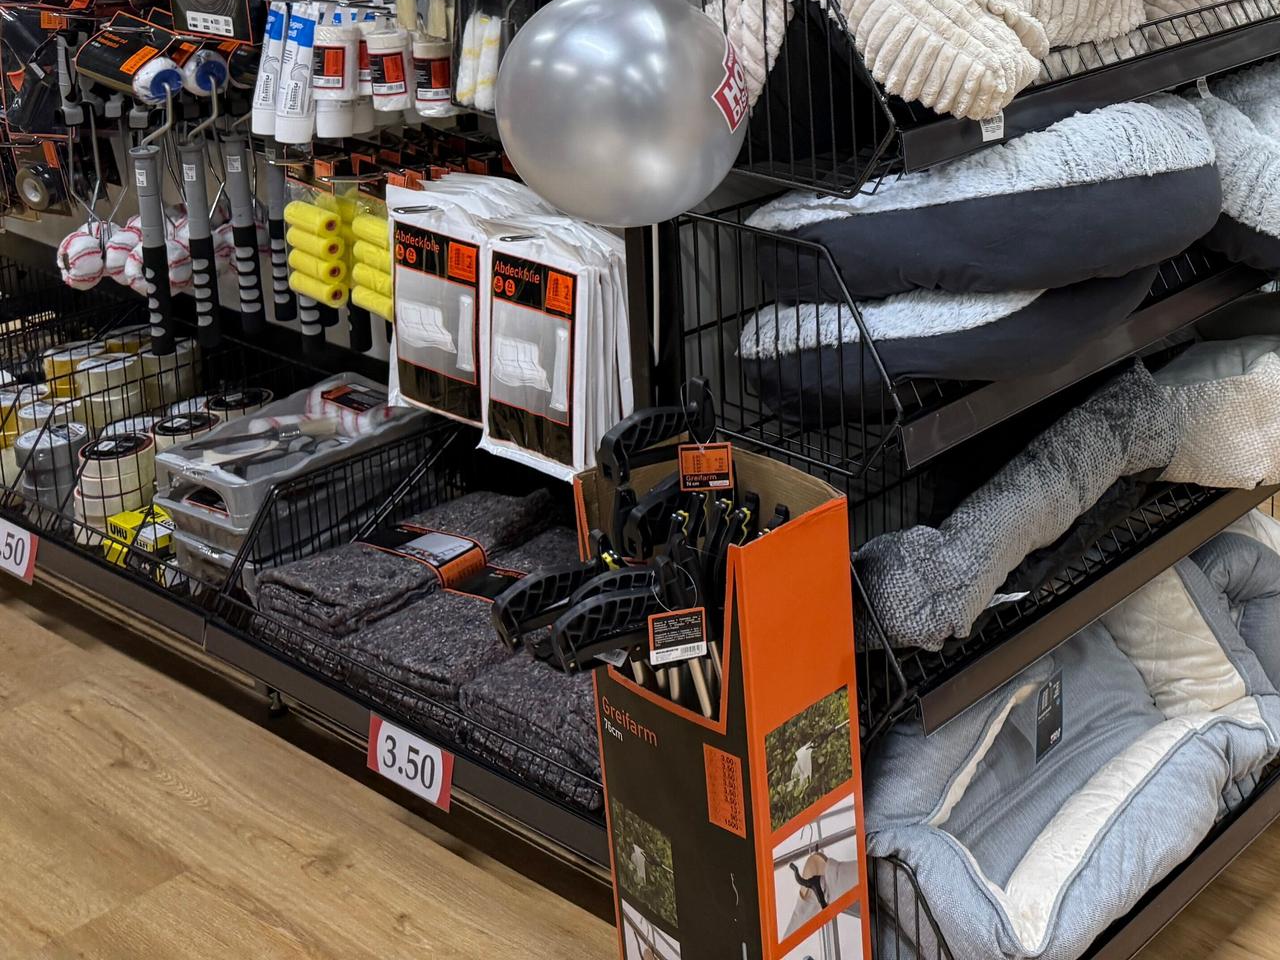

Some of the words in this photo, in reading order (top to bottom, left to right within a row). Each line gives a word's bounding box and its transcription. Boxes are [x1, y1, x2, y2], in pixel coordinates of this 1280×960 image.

[494, 260, 540, 284] Abdeckfolie
[109, 523, 128, 540] UHU
[602, 695, 658, 748] Greifarm
[383, 734, 435, 789] 3.50
